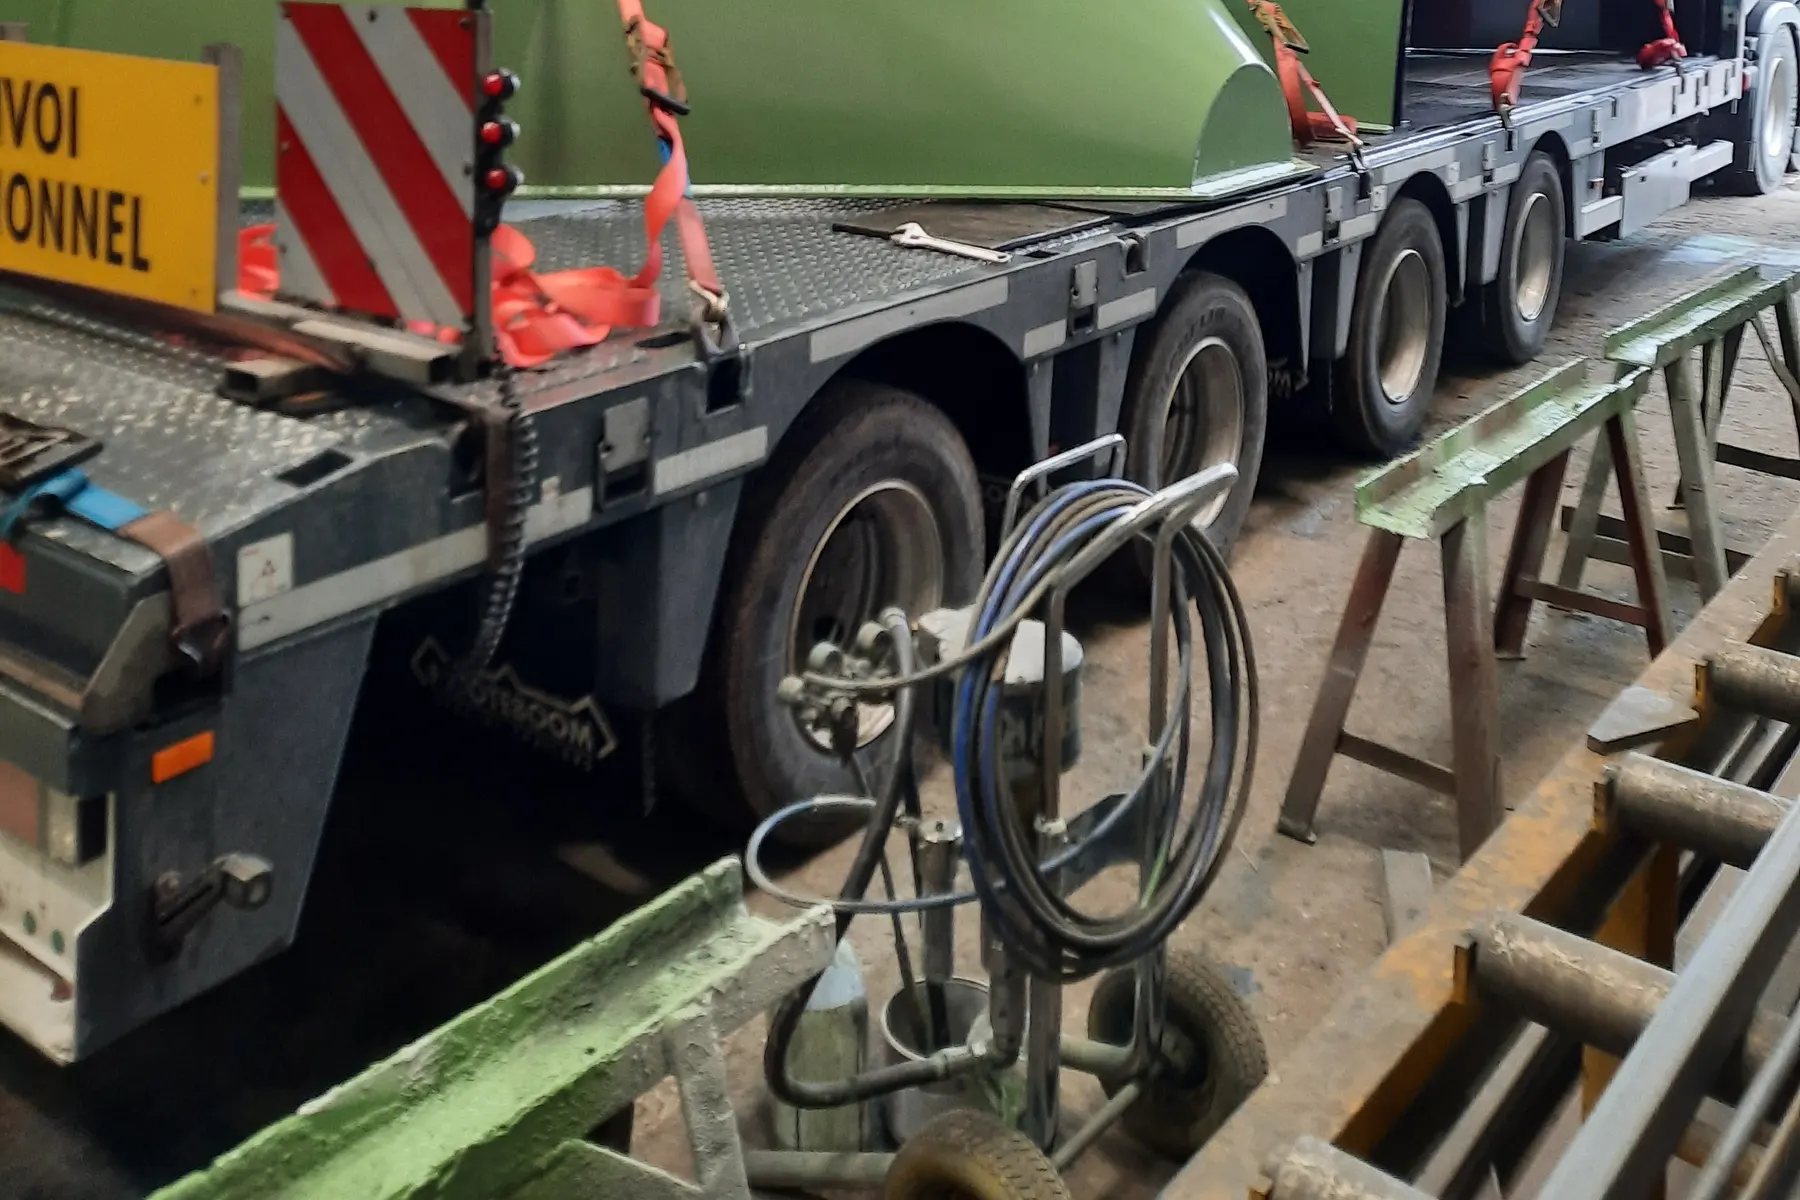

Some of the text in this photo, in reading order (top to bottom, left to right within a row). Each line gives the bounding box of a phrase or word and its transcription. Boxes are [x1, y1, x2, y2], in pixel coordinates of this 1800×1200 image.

[0, 76, 78, 158] VOI
[0, 168, 151, 272] ONNEL
[429, 662, 595, 752] OTEBOOM
